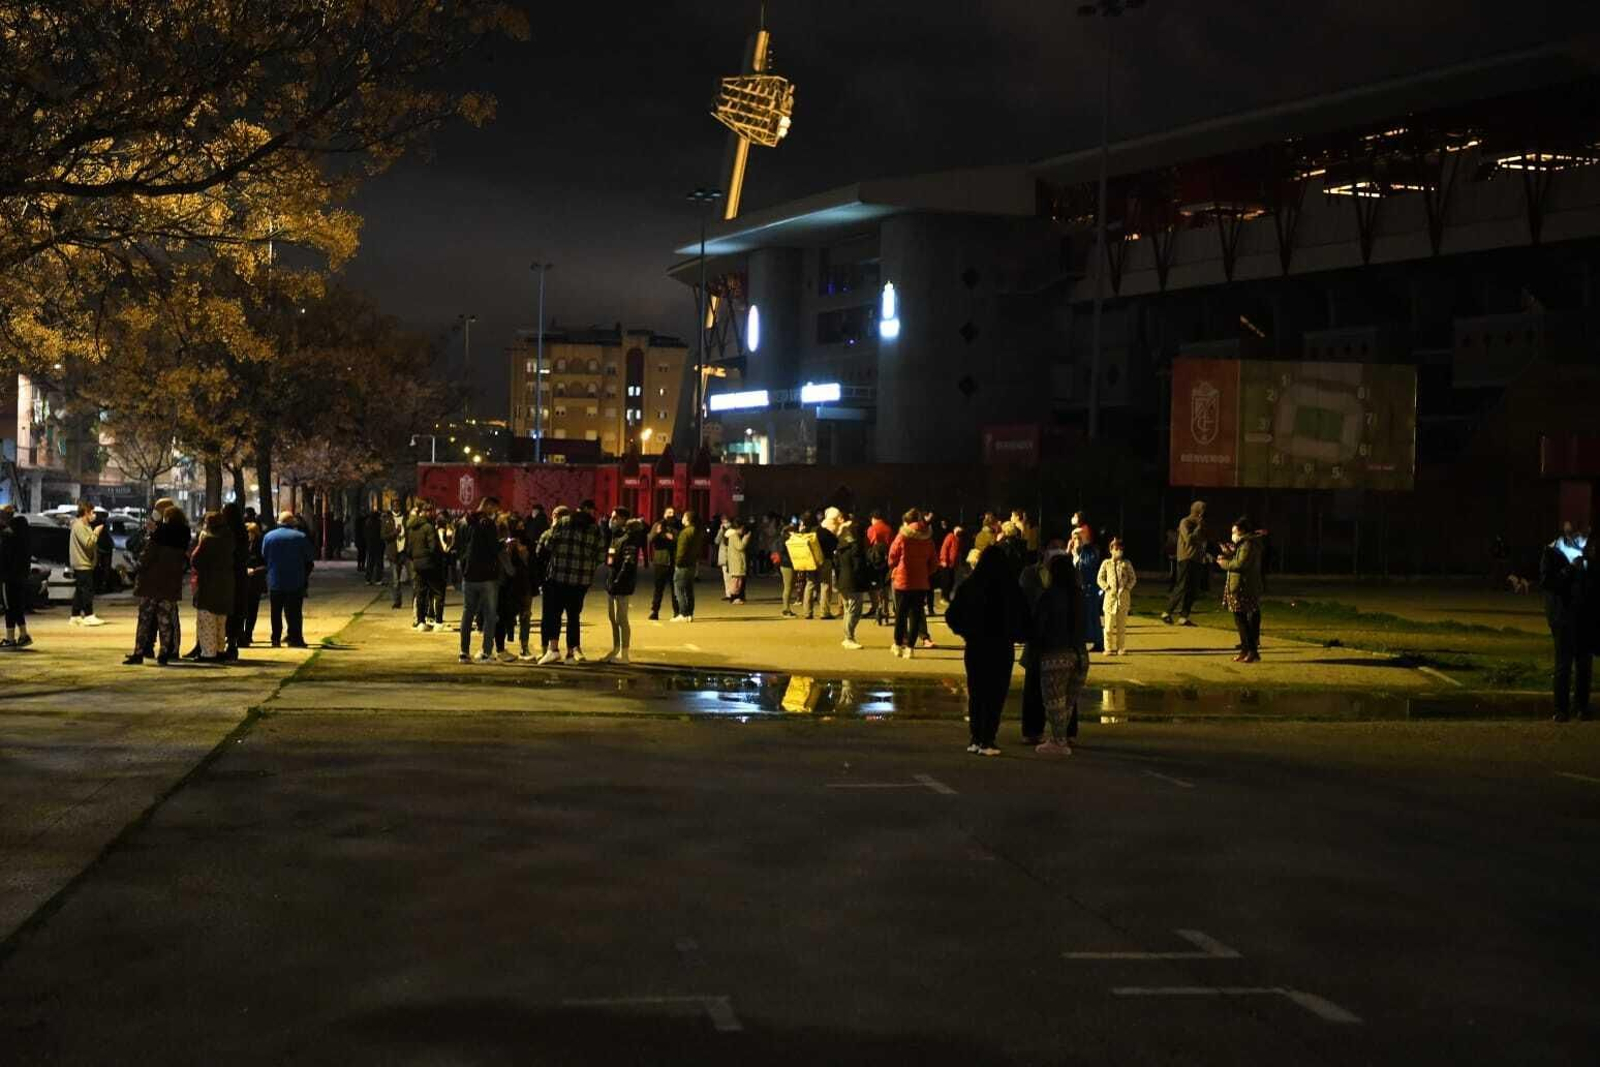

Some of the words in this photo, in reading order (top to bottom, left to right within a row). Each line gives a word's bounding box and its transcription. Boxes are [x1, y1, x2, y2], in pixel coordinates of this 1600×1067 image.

[1266, 389, 1274, 401] 2
[1365, 412, 1373, 424] 7
[1358, 443, 1367, 456] 6
[1331, 466, 1340, 479] 5
